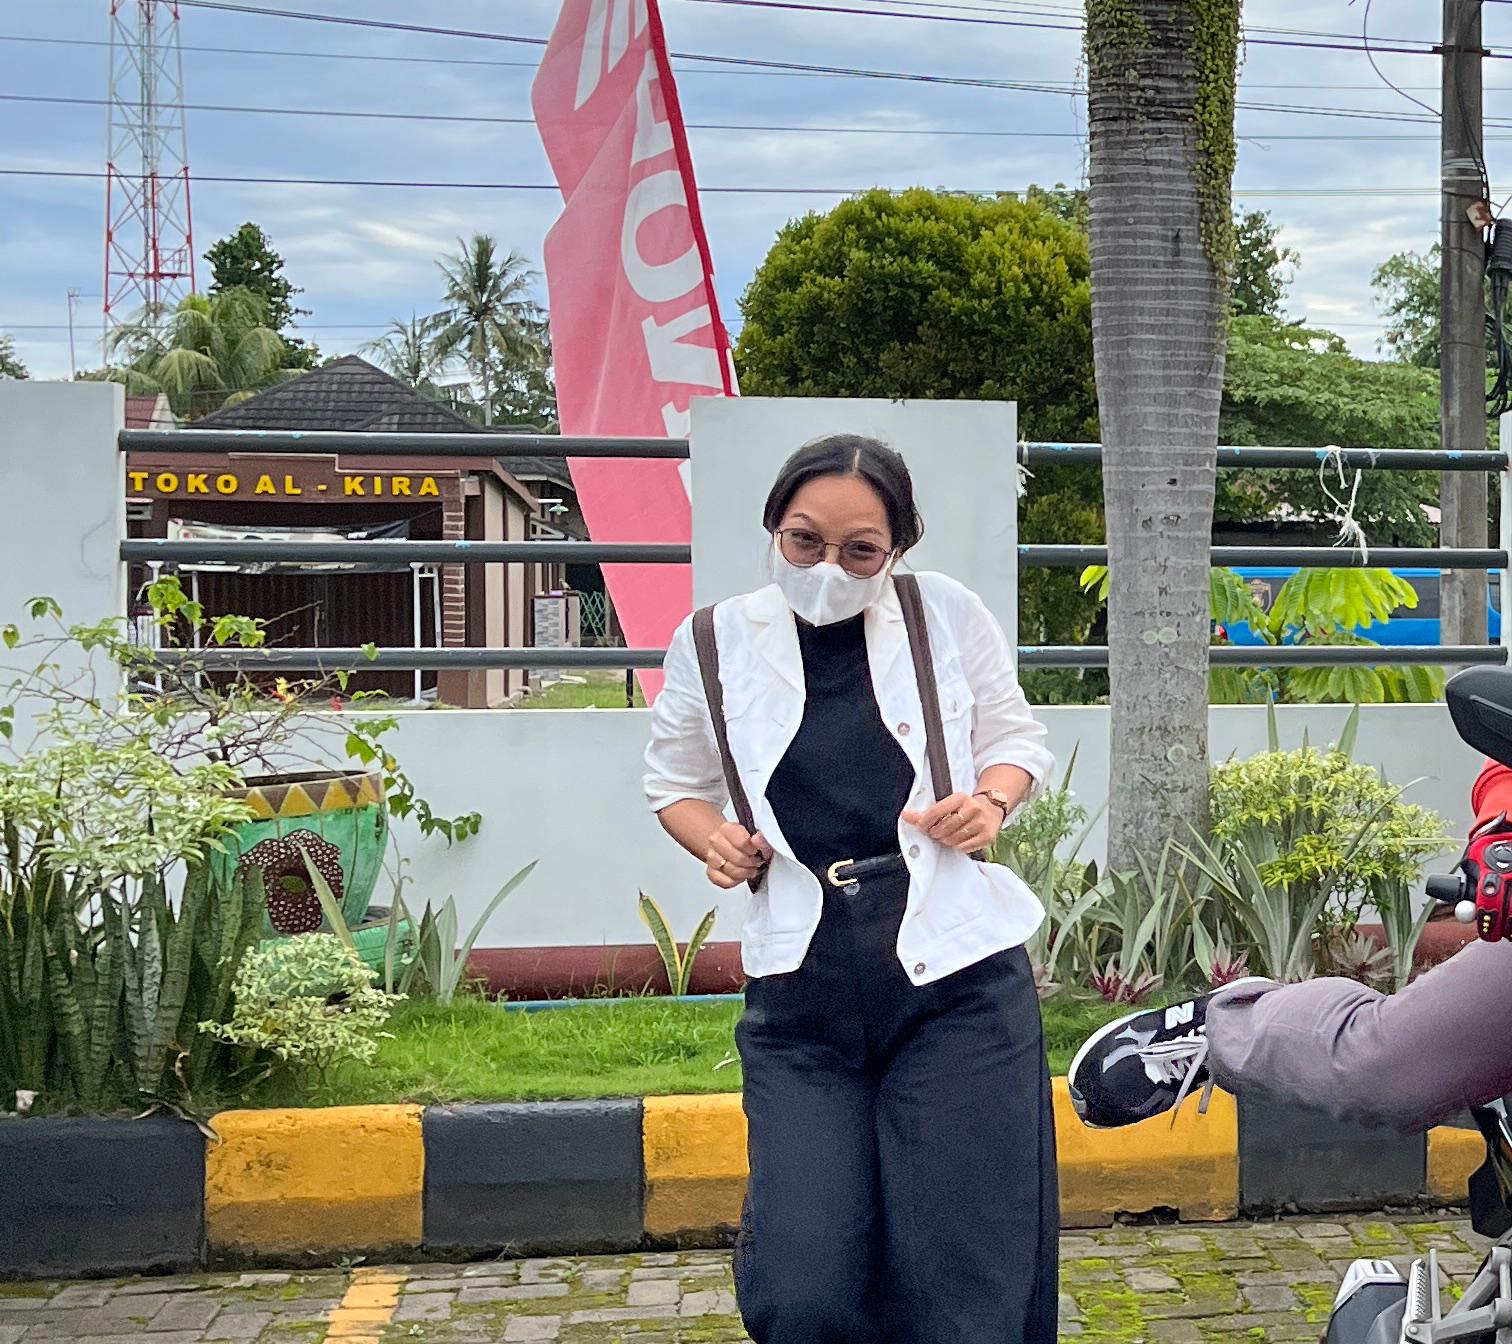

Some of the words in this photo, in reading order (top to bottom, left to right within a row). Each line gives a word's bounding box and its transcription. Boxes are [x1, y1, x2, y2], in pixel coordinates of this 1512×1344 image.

[127, 471, 239, 494] TOKO
[255, 474, 302, 495] AL
[343, 476, 441, 497] KIRA
